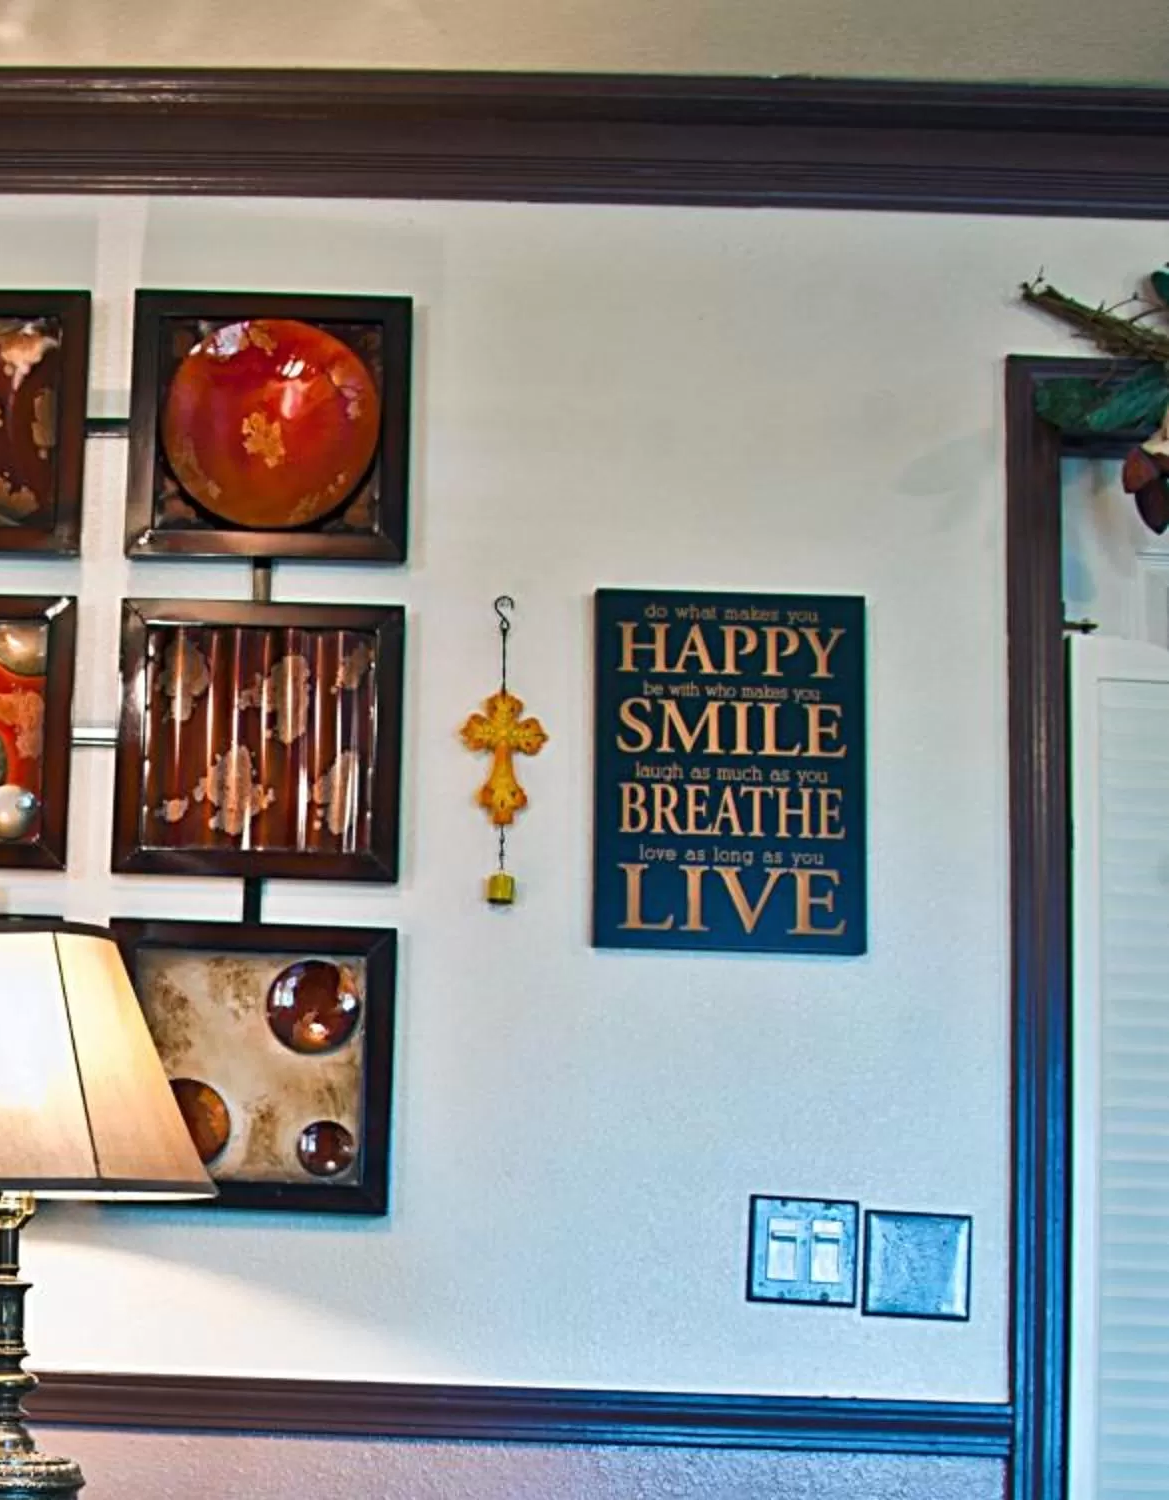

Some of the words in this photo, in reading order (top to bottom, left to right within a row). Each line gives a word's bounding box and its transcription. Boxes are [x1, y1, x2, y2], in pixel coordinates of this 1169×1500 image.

[644, 603, 668, 618] do
[674, 604, 717, 620] what
[724, 605, 780, 621] makes
[786, 610, 819, 624] you
[616, 621, 846, 678] HAPPY
[643, 680, 664, 696] be
[669, 681, 700, 697] with
[705, 683, 736, 698] who
[741, 685, 788, 700] makes
[792, 688, 820, 702] you
[616, 697, 847, 758] SMILE
[635, 761, 684, 781] laugh
[690, 767, 711, 780] as
[716, 765, 763, 781] much
[769, 768, 791, 782] as
[796, 770, 829, 785] you
[619, 782, 846, 839] BREATHE
[639, 844, 678, 861] love
[685, 848, 706, 862] as
[712, 846, 754, 866] long
[762, 850, 784, 864] as
[790, 852, 825, 867] you
[617, 863, 846, 935] LIVE
